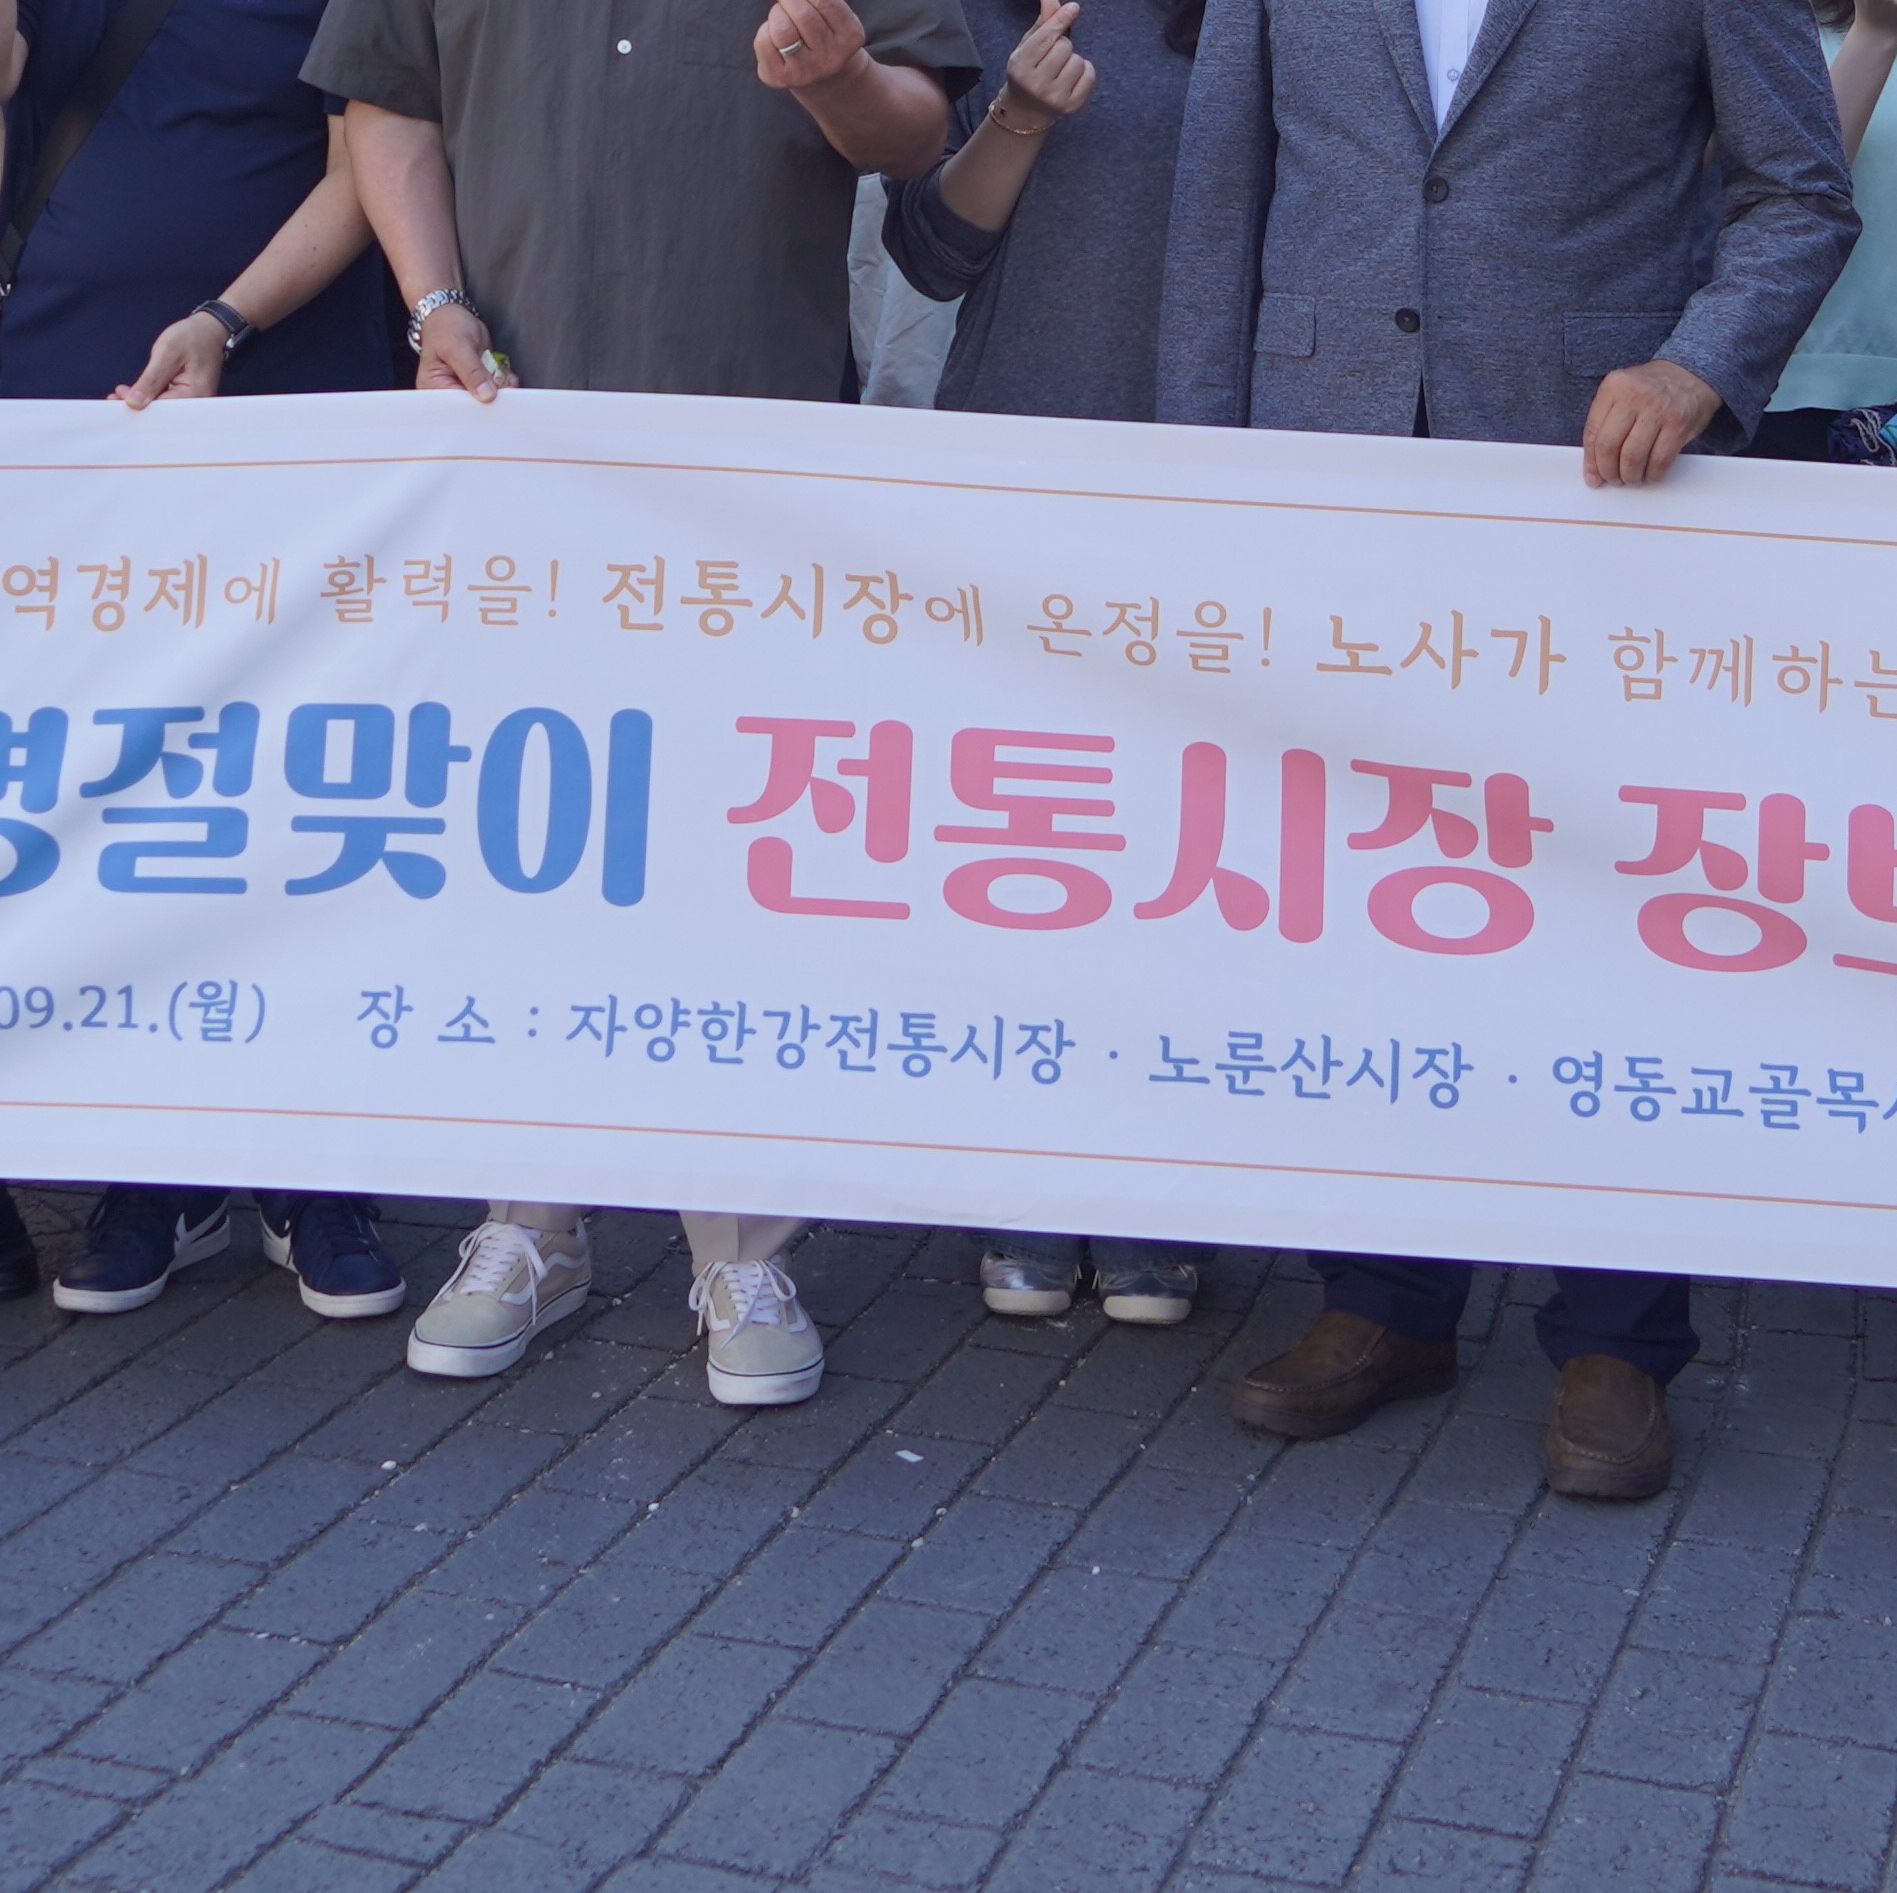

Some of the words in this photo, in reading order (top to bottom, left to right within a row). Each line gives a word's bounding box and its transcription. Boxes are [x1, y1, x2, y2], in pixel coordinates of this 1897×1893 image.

[317, 550, 561, 630] 활력을!
[601, 551, 988, 648] 전통시장에
[1024, 584, 1277, 677] 온정을!
[1314, 609, 1569, 701] 노사가
[726, 712, 1555, 958] 전통시장
[355, 987, 413, 1052] 장
[437, 996, 498, 1048] 소
[566, 993, 1077, 1088] 자양한강전통시장
[1148, 1029, 1475, 1113] 노룬산시장
